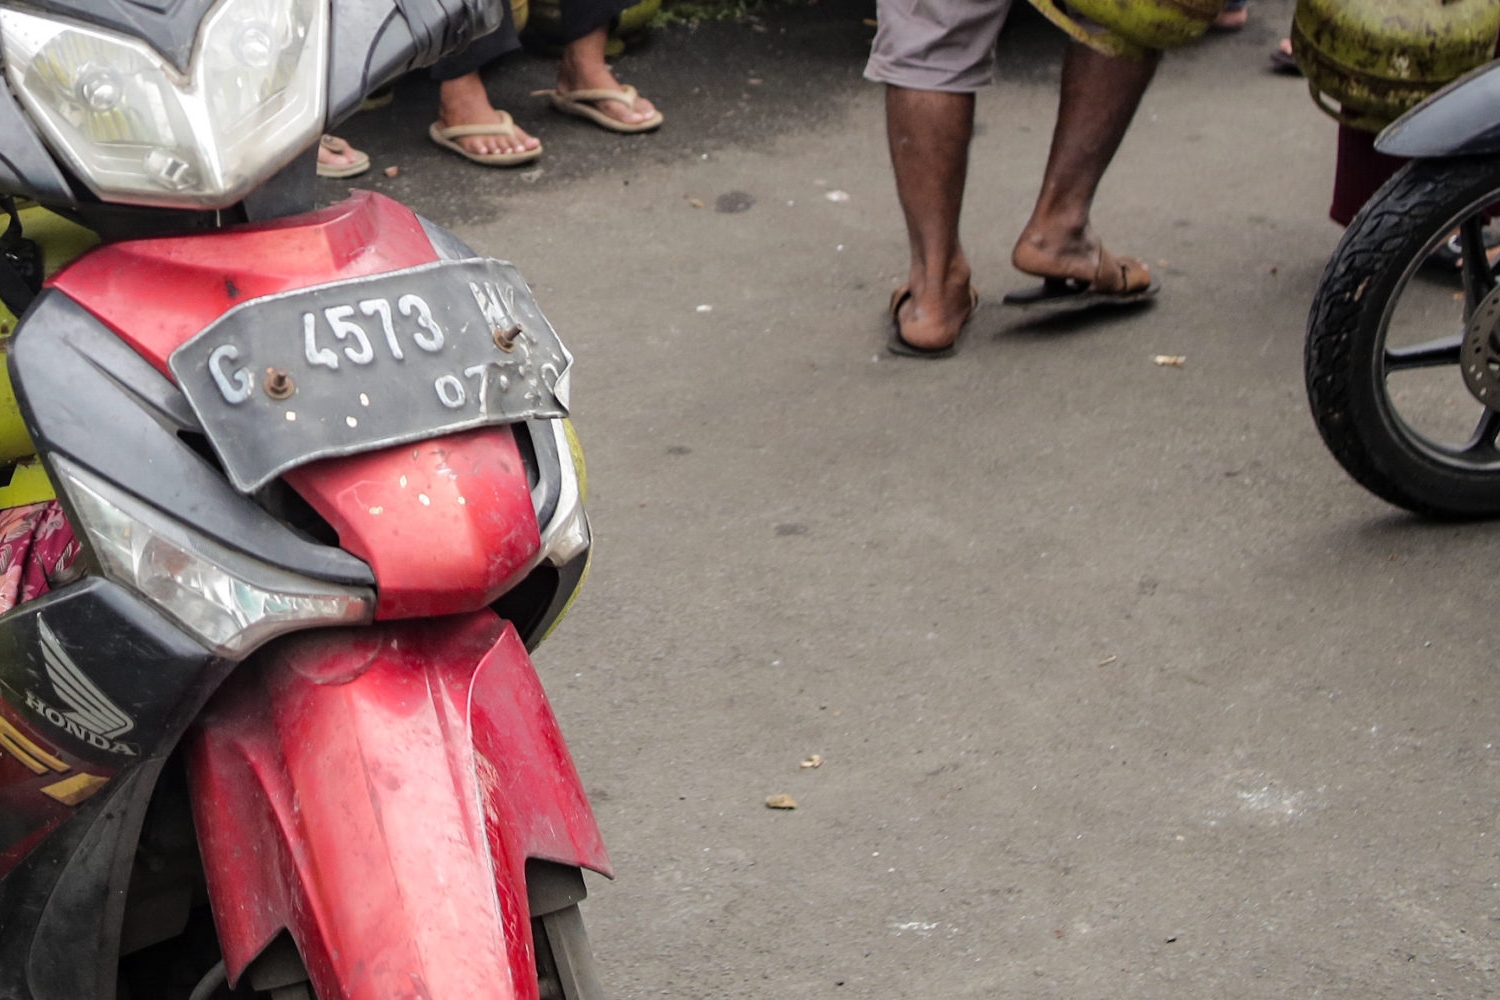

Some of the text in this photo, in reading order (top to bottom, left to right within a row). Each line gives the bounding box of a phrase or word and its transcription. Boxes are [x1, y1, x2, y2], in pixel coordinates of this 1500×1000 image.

[208, 344, 254, 405] G
[303, 292, 445, 370] 4573
[25, 690, 139, 757] HONDA
